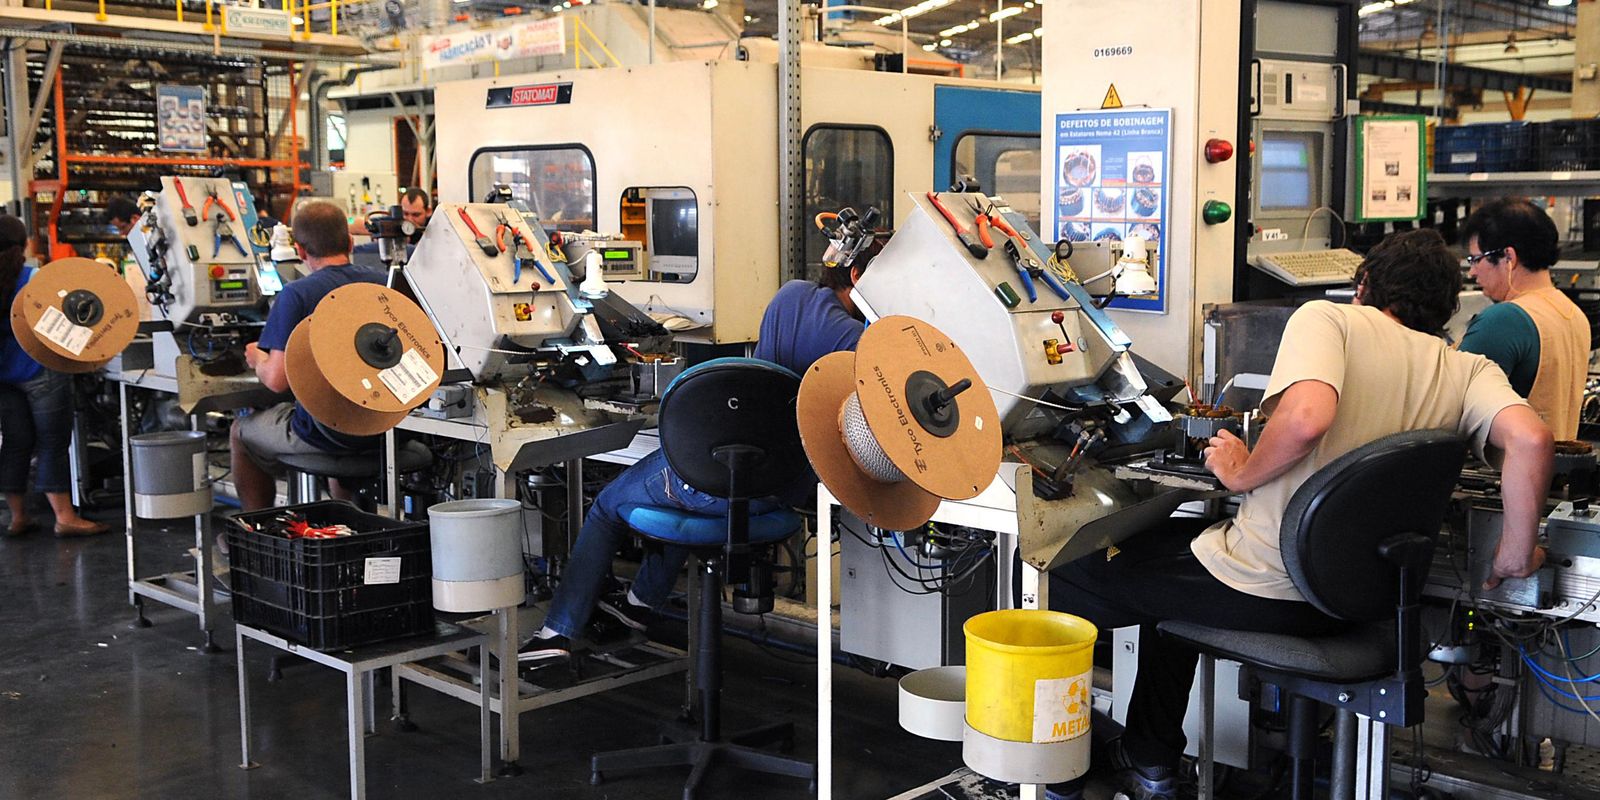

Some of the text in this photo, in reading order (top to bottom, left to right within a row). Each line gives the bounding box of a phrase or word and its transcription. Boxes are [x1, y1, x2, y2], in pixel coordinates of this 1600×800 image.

[1094, 46, 1133, 57] 0169669
[514, 87, 556, 102] STATOMAT
[1060, 116, 1164, 128] DEFEITOS DE BOBINAGEM
[384, 304, 398, 322] Tyco
[397, 321, 431, 359] Electronics
[873, 365, 922, 456] Tyco Electronics
[1052, 715, 1089, 738] META
